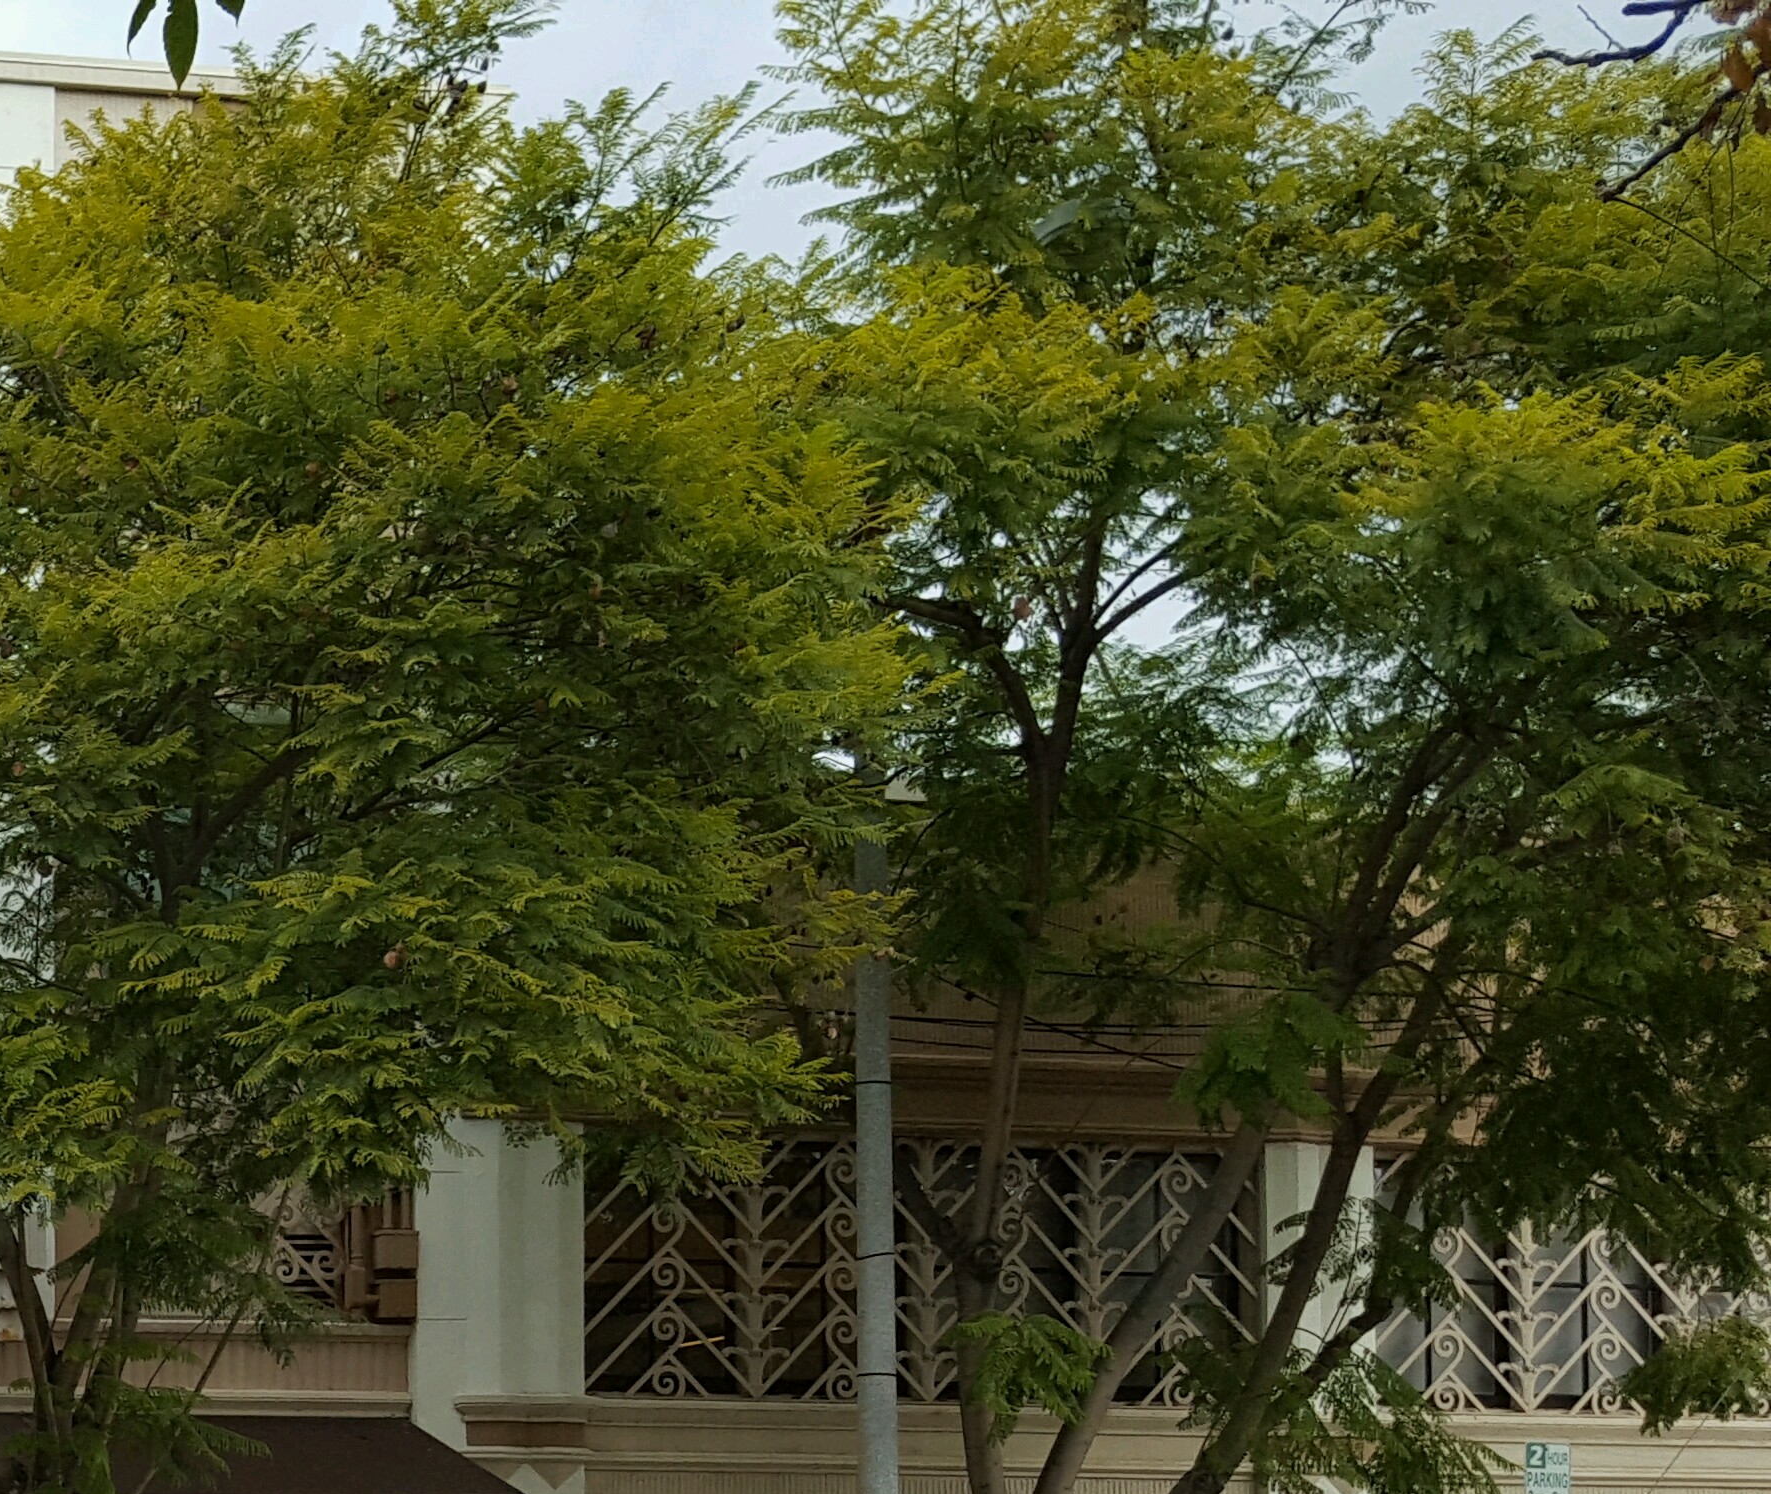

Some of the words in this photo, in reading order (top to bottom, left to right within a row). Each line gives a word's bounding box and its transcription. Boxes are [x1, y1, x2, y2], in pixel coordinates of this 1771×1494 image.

[1529, 1445, 1543, 1466] 2
[1547, 1452, 1568, 1466] HOUR
[1527, 1471, 1568, 1489] PARKING
